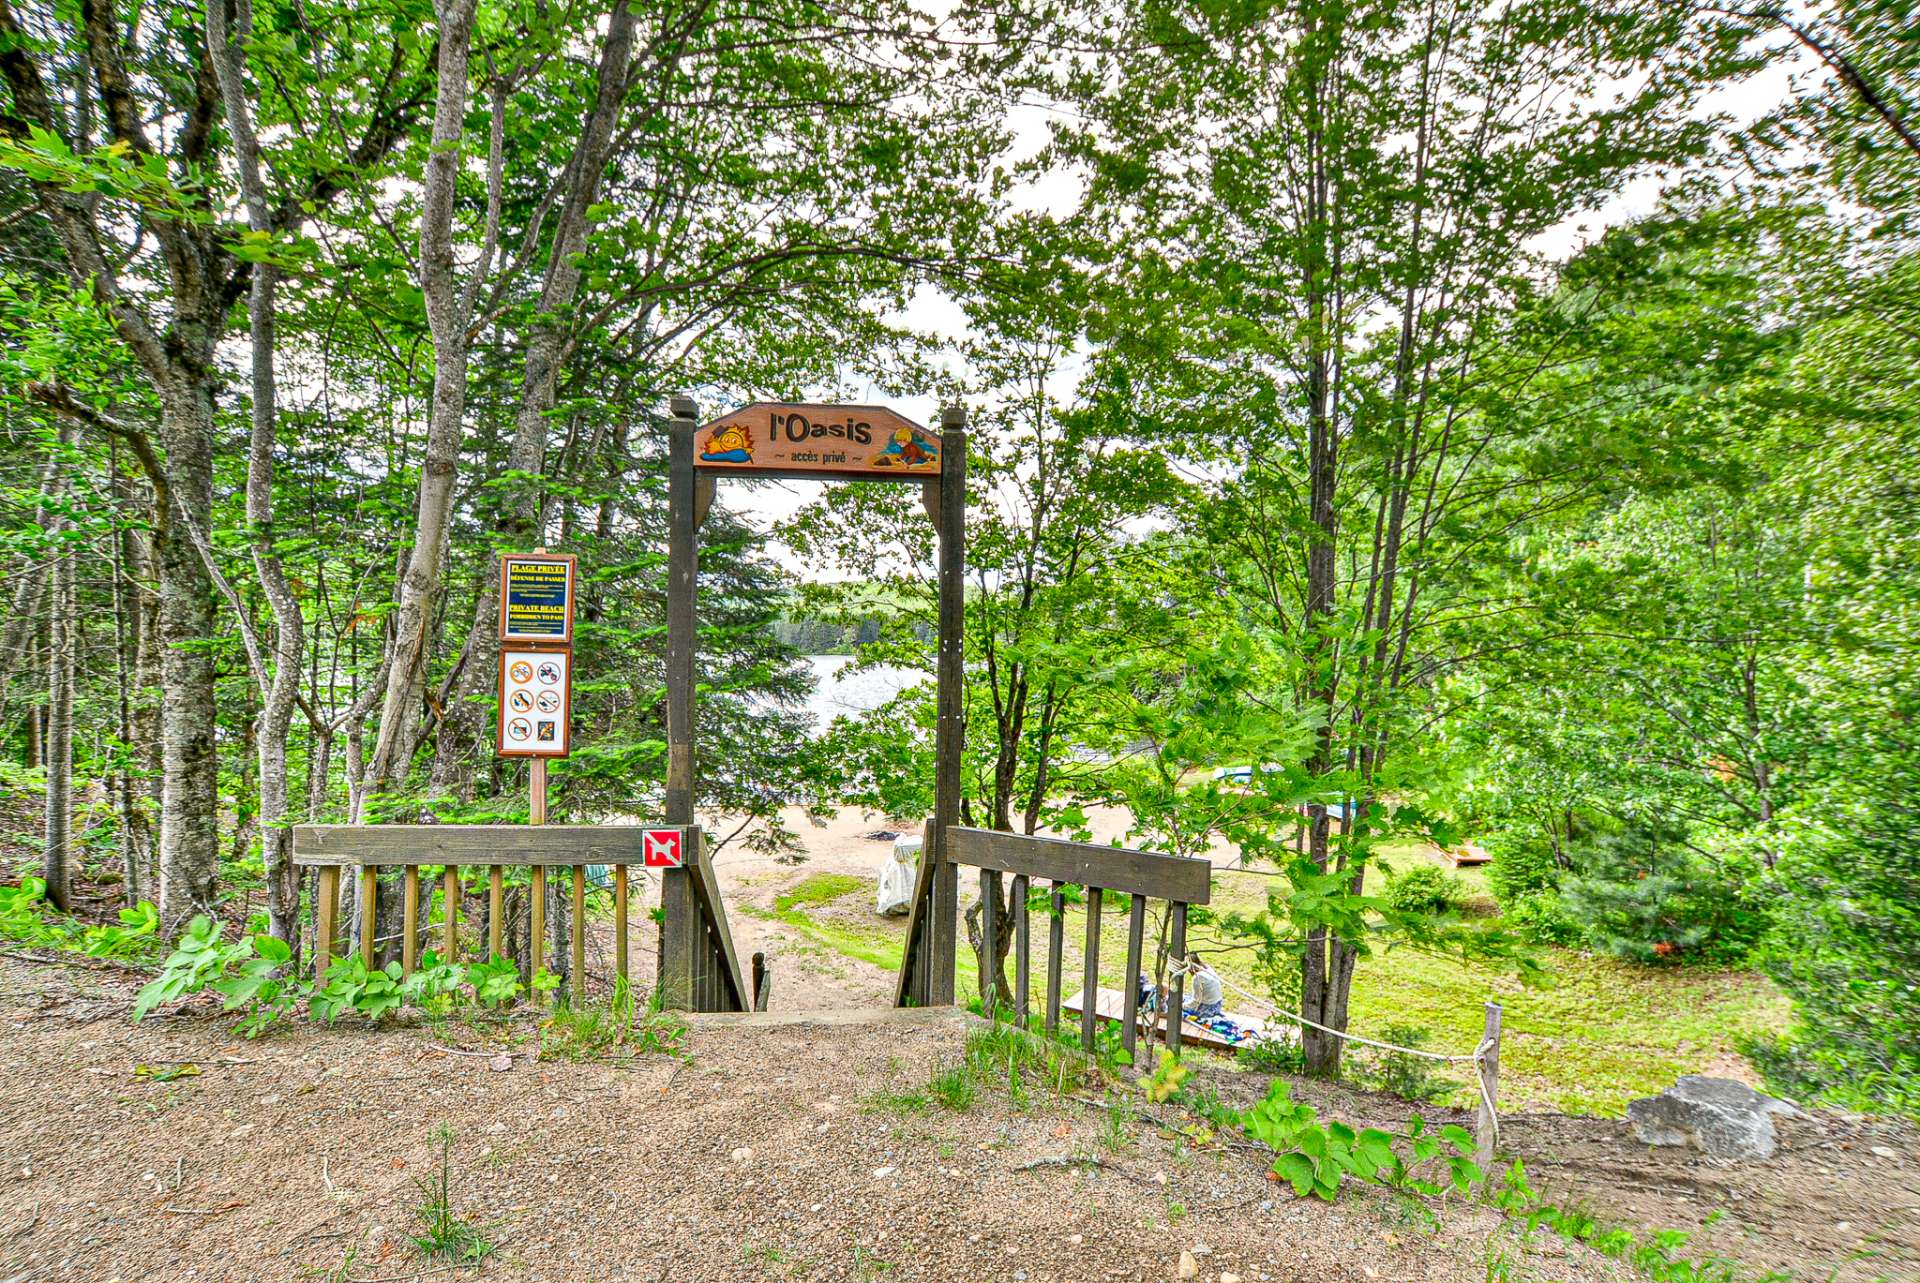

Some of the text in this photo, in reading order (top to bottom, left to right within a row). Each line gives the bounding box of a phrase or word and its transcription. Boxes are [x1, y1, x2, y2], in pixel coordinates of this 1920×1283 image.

[770, 413, 872, 445] l'Oasis
[791, 451, 847, 465] accès privé
[511, 564, 565, 574] PLAGE PRIVÉE
[510, 604, 564, 613] PRIVATE BEACH
